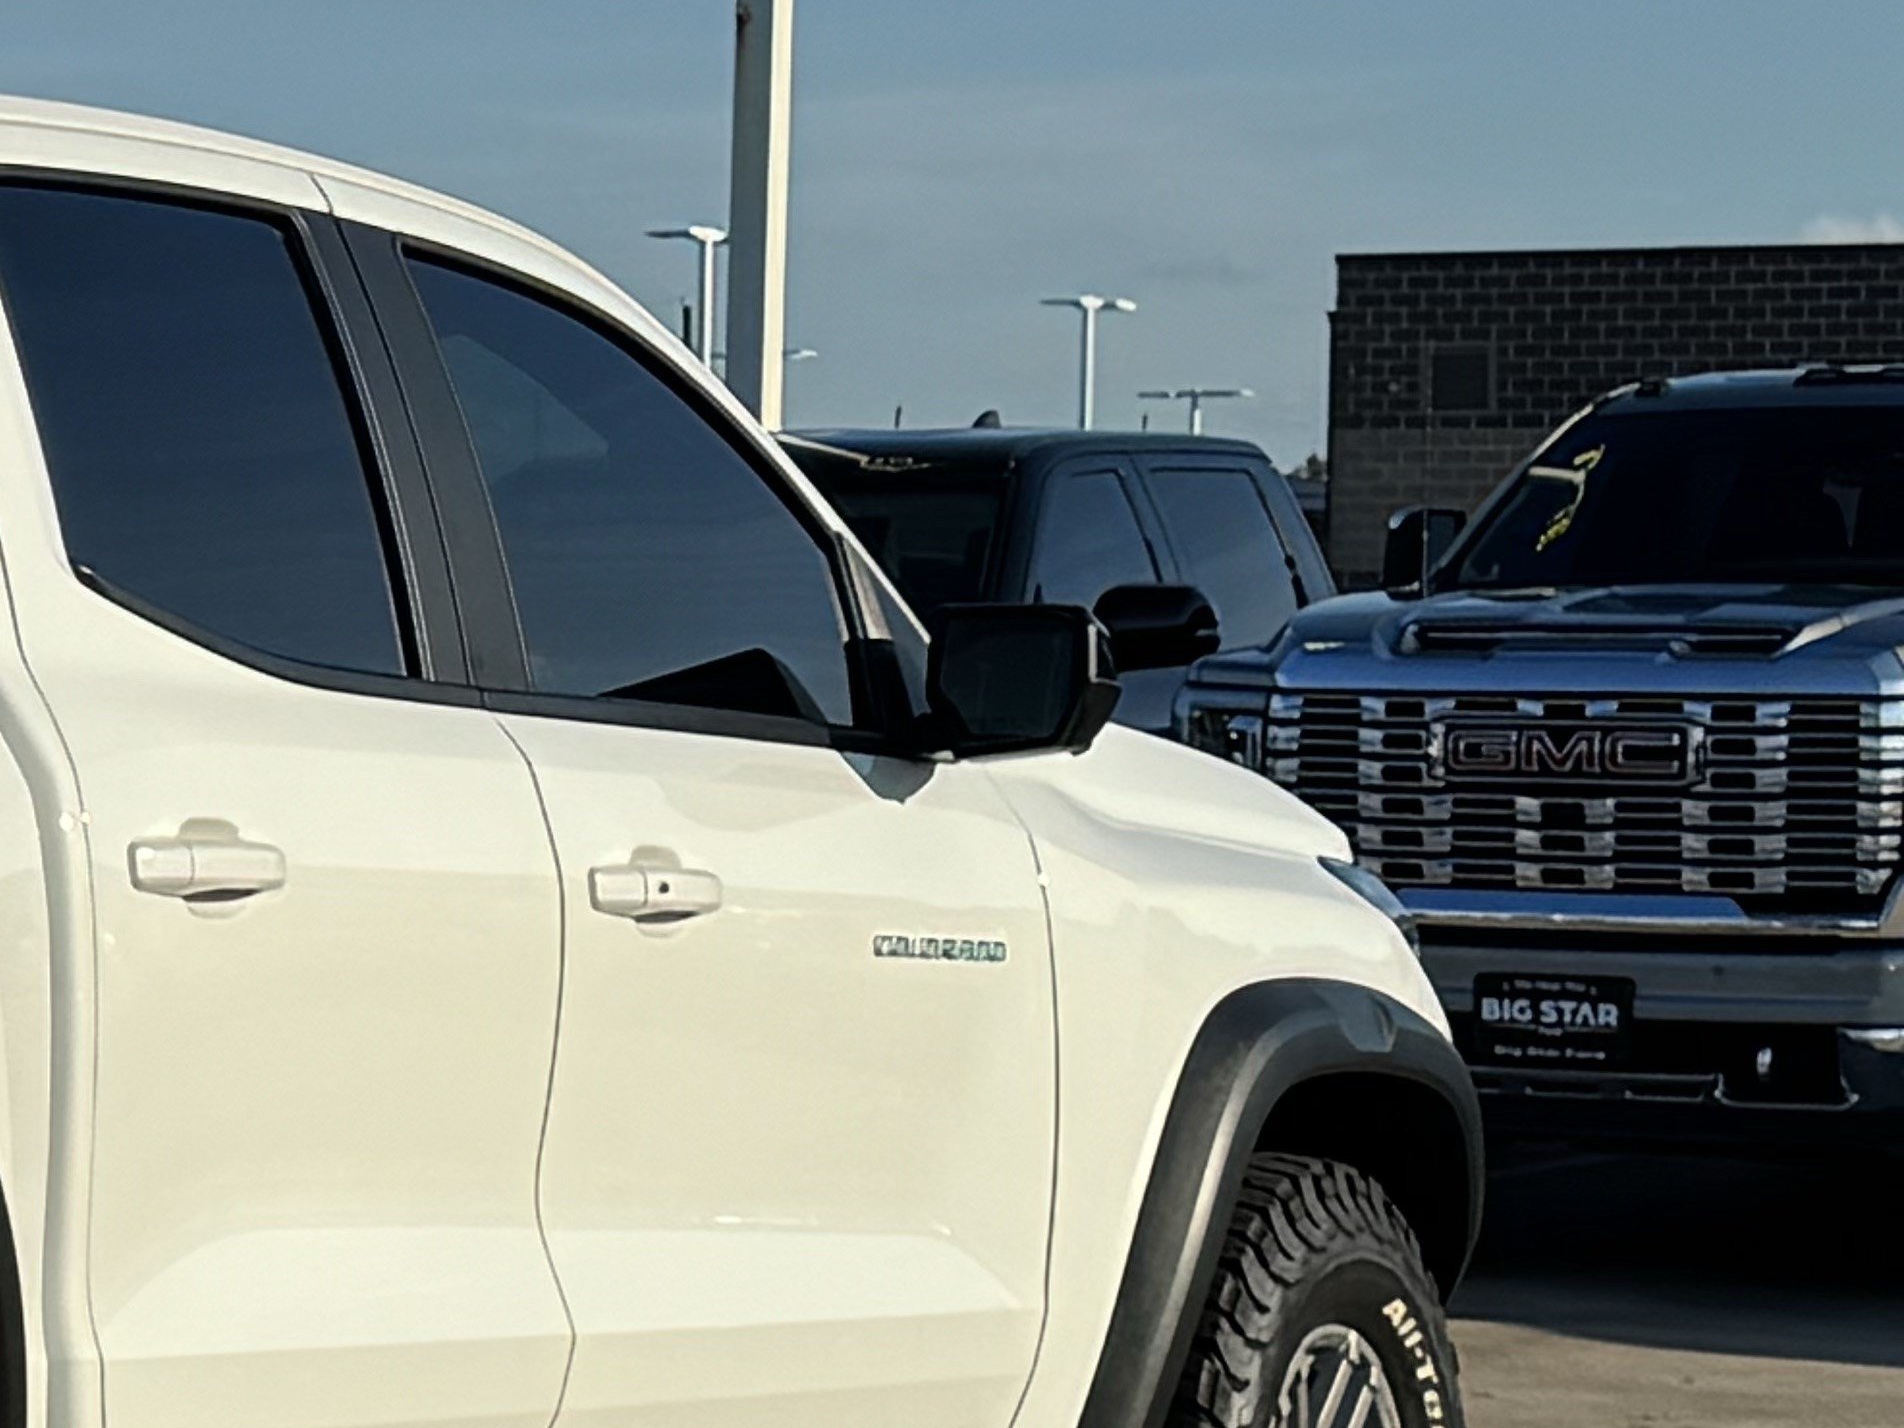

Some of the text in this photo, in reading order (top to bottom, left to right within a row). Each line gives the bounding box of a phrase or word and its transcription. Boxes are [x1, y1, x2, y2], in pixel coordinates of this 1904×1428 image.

[1447, 729, 1681, 773] GMC
[1481, 997, 1619, 1026] BIG STAR
